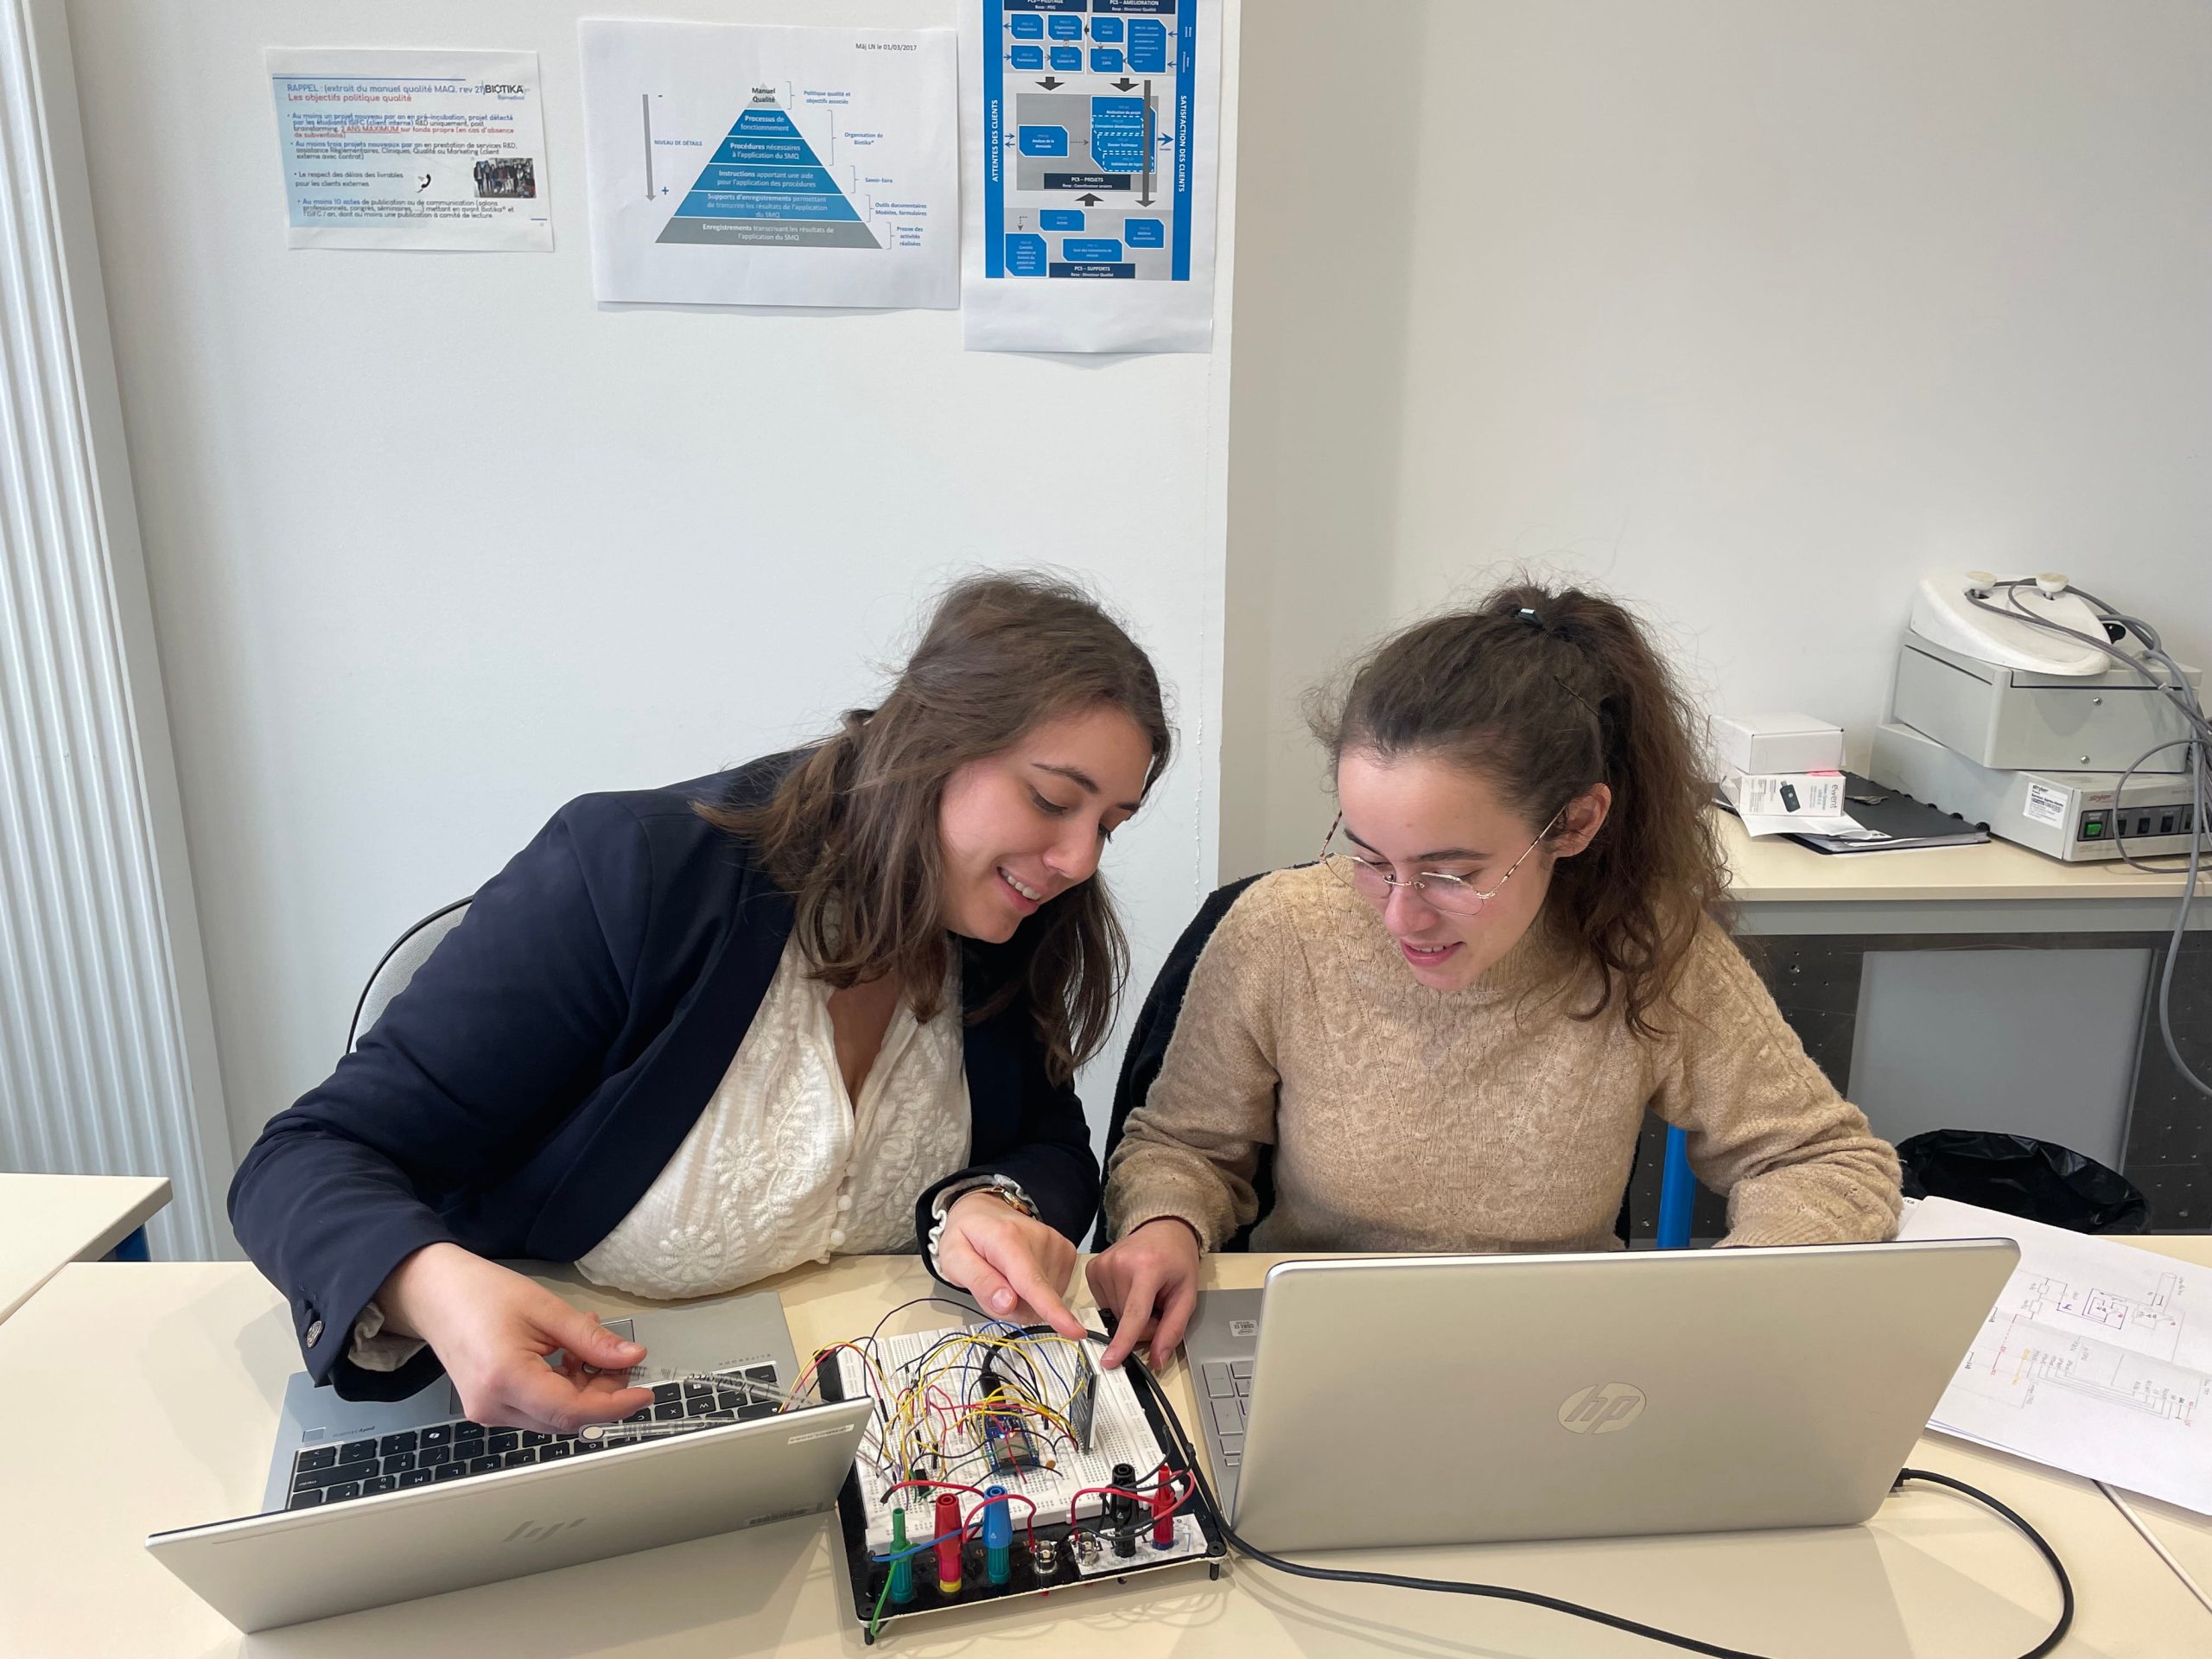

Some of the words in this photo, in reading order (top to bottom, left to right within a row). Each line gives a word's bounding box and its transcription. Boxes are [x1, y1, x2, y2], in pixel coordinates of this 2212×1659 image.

[287, 84, 318, 92] RAPPEL
[324, 85, 354, 93] (extrait
[403, 85, 432, 94] qualité
[485, 85, 524, 94] BIOTIKA
[305, 94, 341, 103] objectifs
[343, 94, 380, 103] politique
[382, 94, 412, 103] qualité
[1179, 95, 1187, 146] SATISFACTION
[737, 151, 774, 160] l'application
[733, 179, 769, 188] l'application
[736, 194, 791, 202] d'enregistrements
[702, 223, 752, 232] Enregistrements
[718, 1354, 771, 1366] ELITEBOOK
[1560, 1382, 1643, 1434] hp
